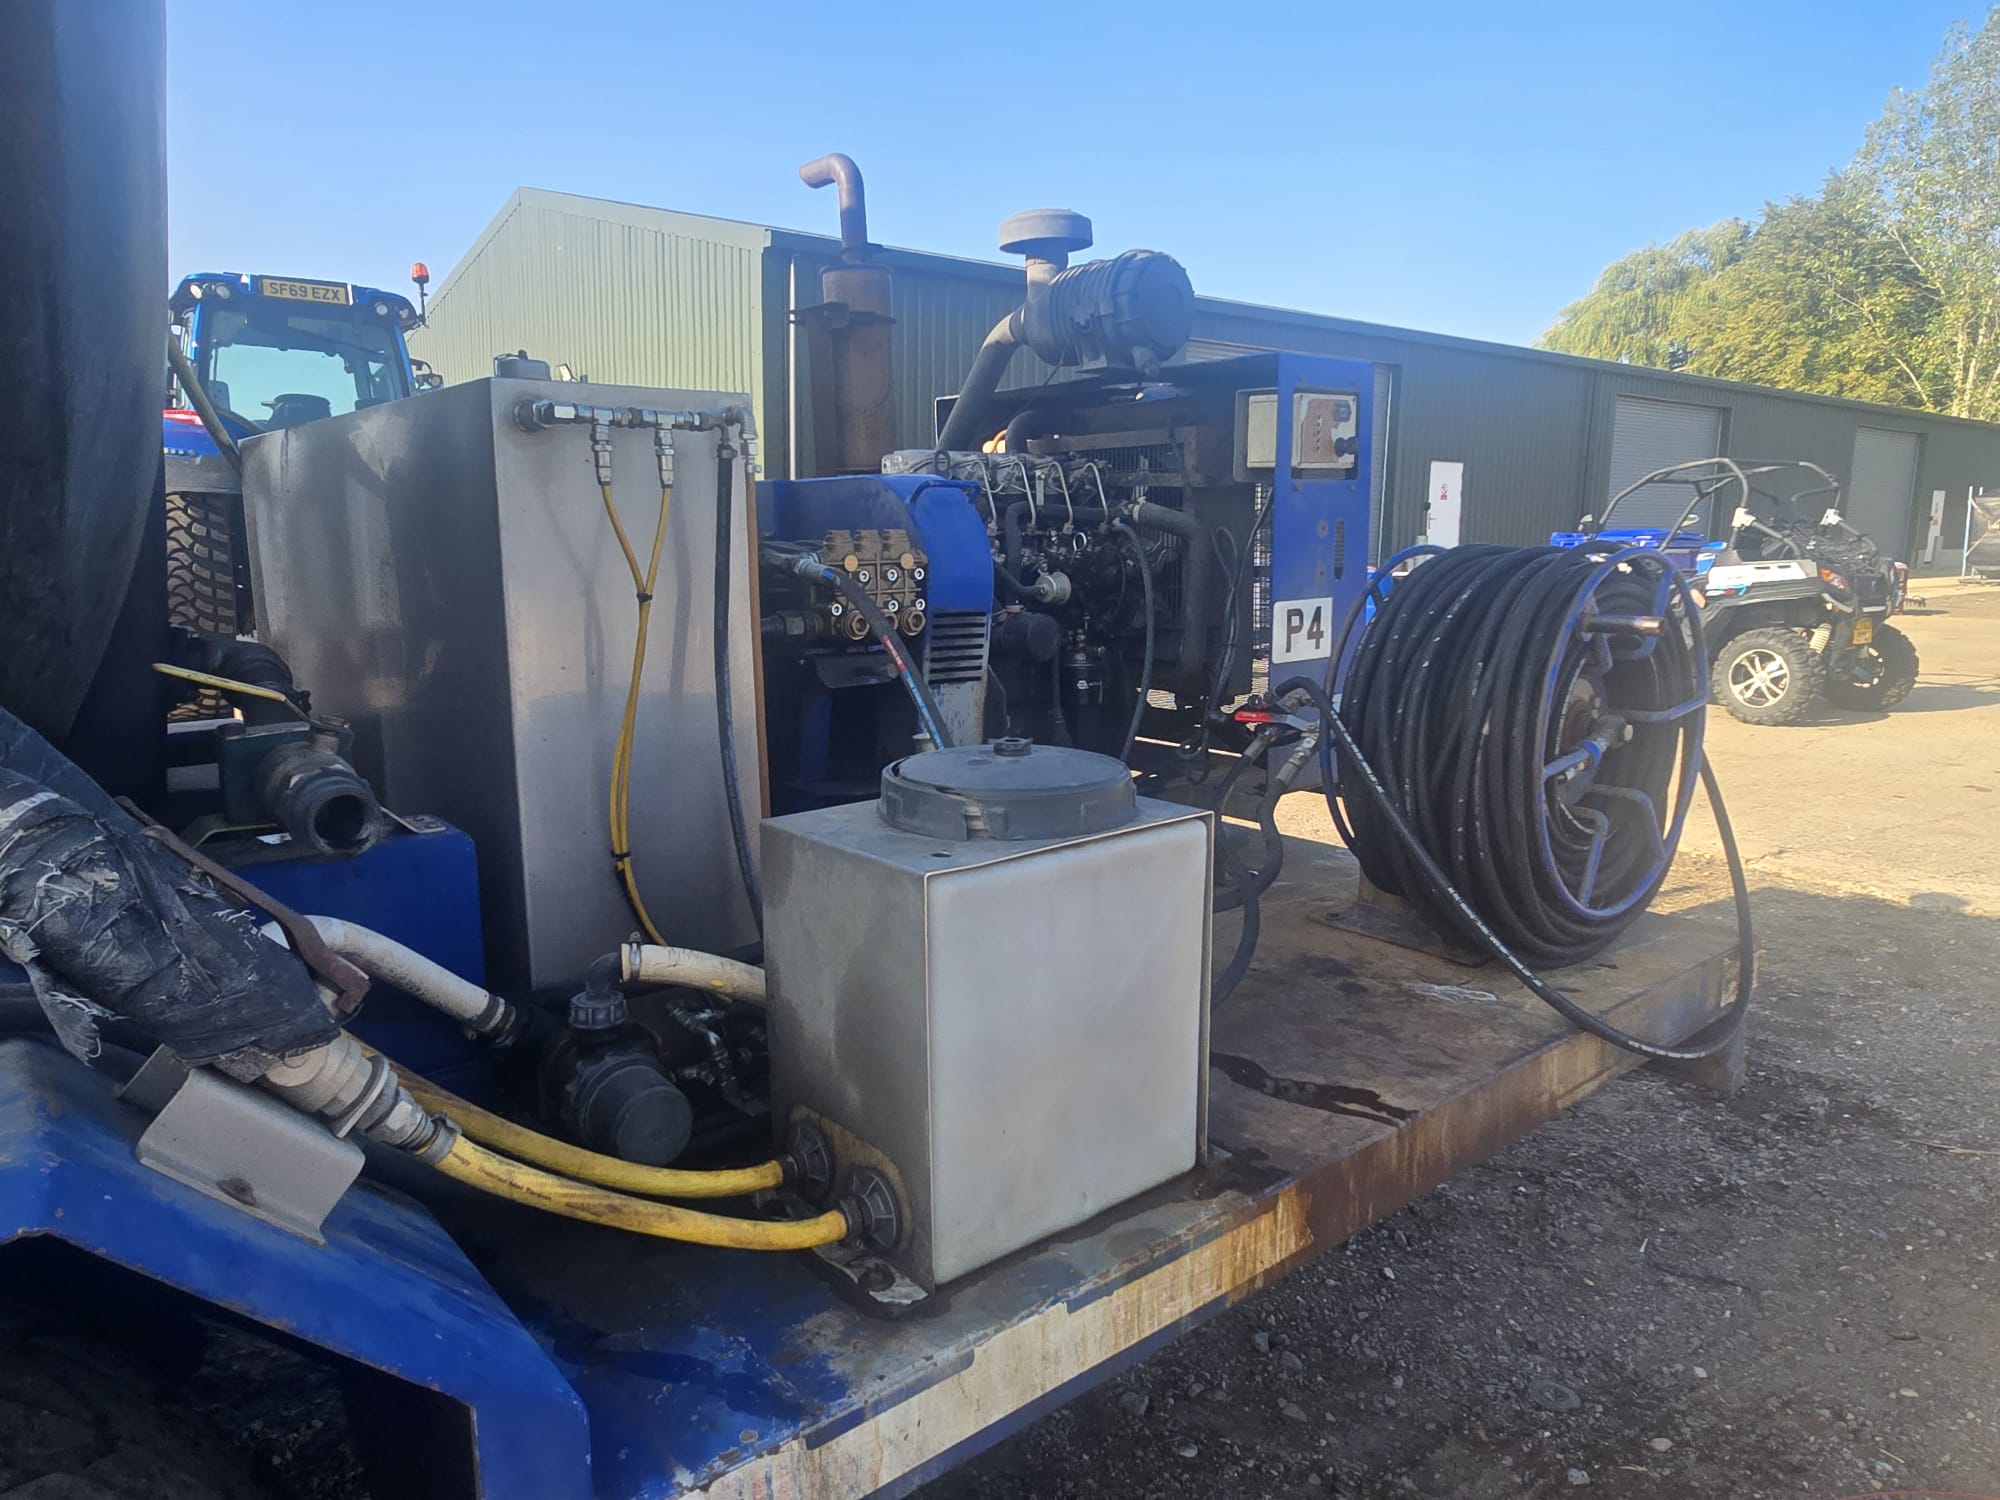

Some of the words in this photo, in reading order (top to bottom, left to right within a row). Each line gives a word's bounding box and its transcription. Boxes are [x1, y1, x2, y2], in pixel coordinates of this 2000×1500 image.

[269, 282, 308, 297] SF69
[312, 287, 340, 301] EZX
[1285, 606, 1324, 653] P4
